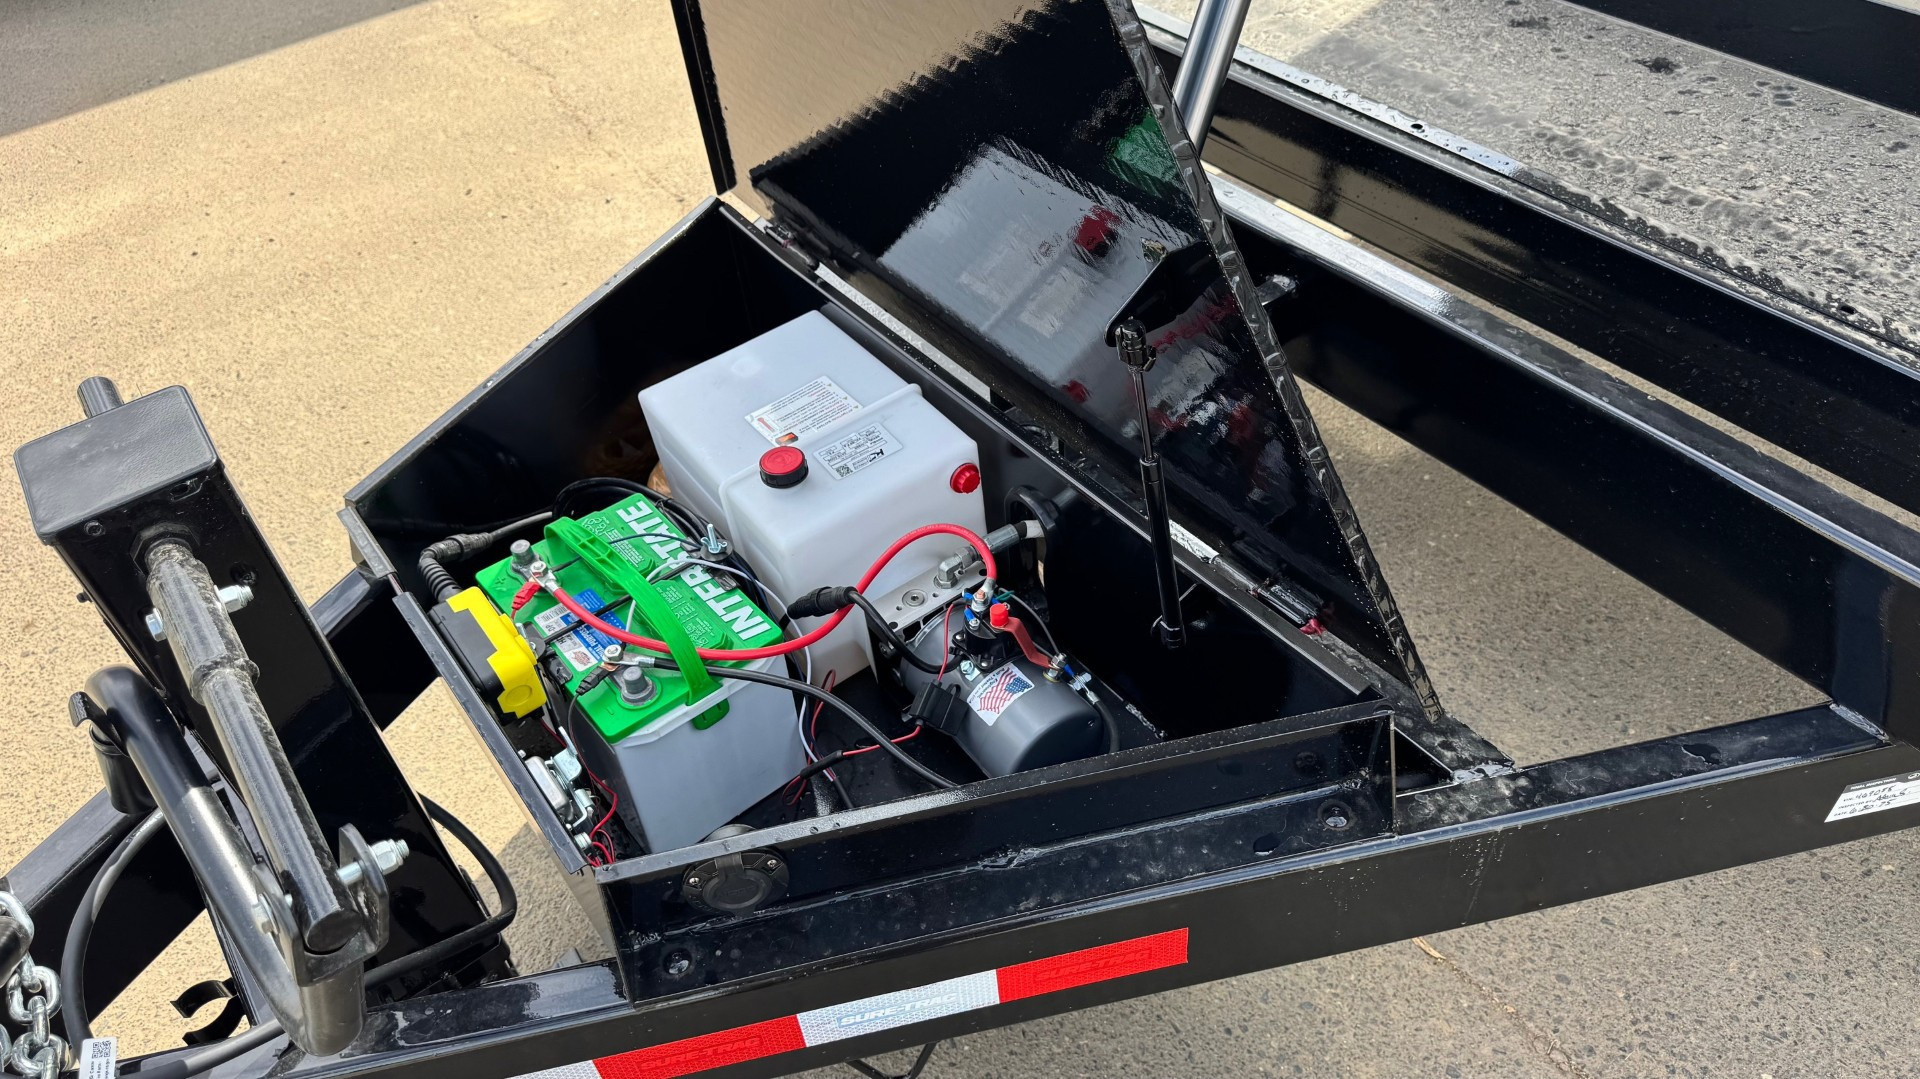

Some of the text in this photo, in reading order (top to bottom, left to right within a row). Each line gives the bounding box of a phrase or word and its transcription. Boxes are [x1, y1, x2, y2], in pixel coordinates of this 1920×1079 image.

[615, 500, 772, 641] INTERSTATE
[1036, 951, 1151, 981] SURE-TRAC
[841, 992, 958, 1027] SURE-TRAC
[640, 1036, 762, 1070] SURE-TRAC
